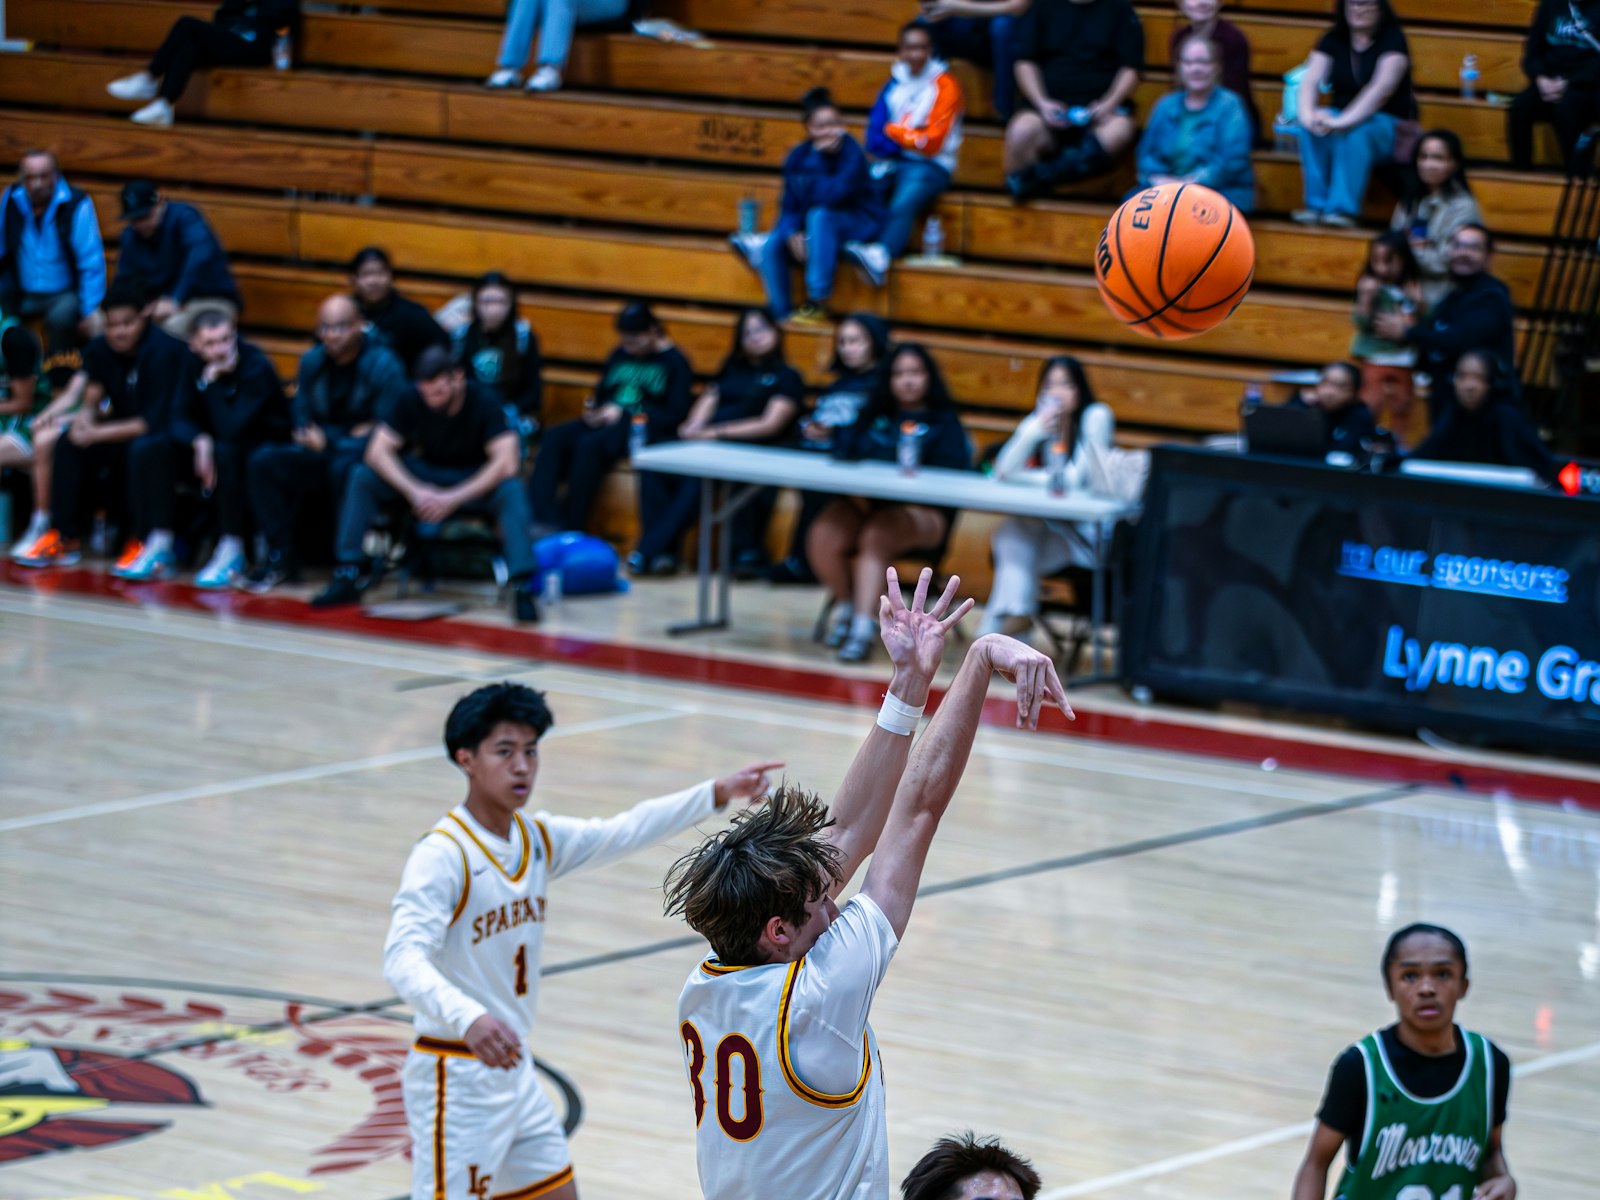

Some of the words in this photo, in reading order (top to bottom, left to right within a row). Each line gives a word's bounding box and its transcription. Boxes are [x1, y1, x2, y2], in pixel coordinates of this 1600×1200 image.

[1374, 546, 1429, 577] our
[1383, 624, 1530, 693] Lynne
[513, 943, 528, 997] 1
[680, 1019, 765, 1142] 30
